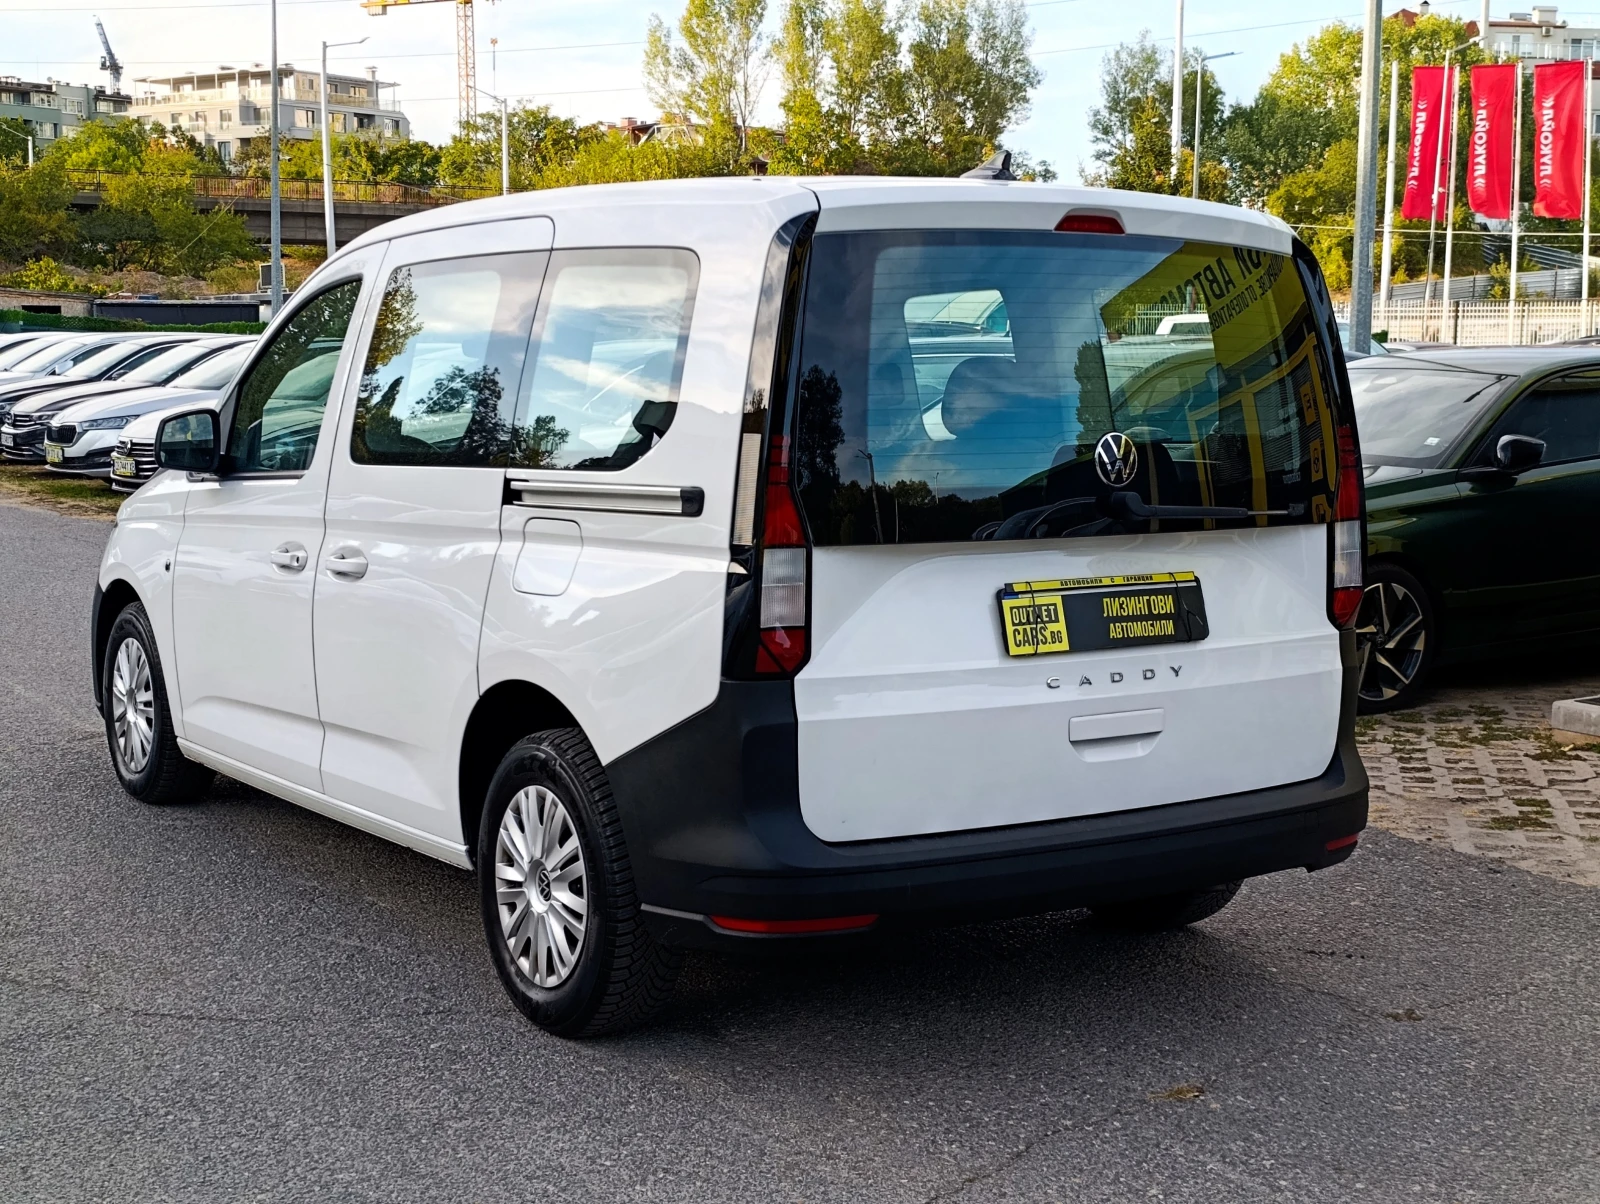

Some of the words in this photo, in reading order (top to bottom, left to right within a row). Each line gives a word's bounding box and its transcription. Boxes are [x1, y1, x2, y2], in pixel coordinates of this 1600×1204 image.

[1060, 578, 1103, 587] АВТОМОБИЛИ
[1122, 575, 1154, 583] ГАРАНЦИЯ
[1102, 594, 1175, 617] ЛИЗИНГОВИ
[1109, 619, 1175, 639] АВТОМОБИЛИ
[1046, 665, 1182, 689] CADDY
